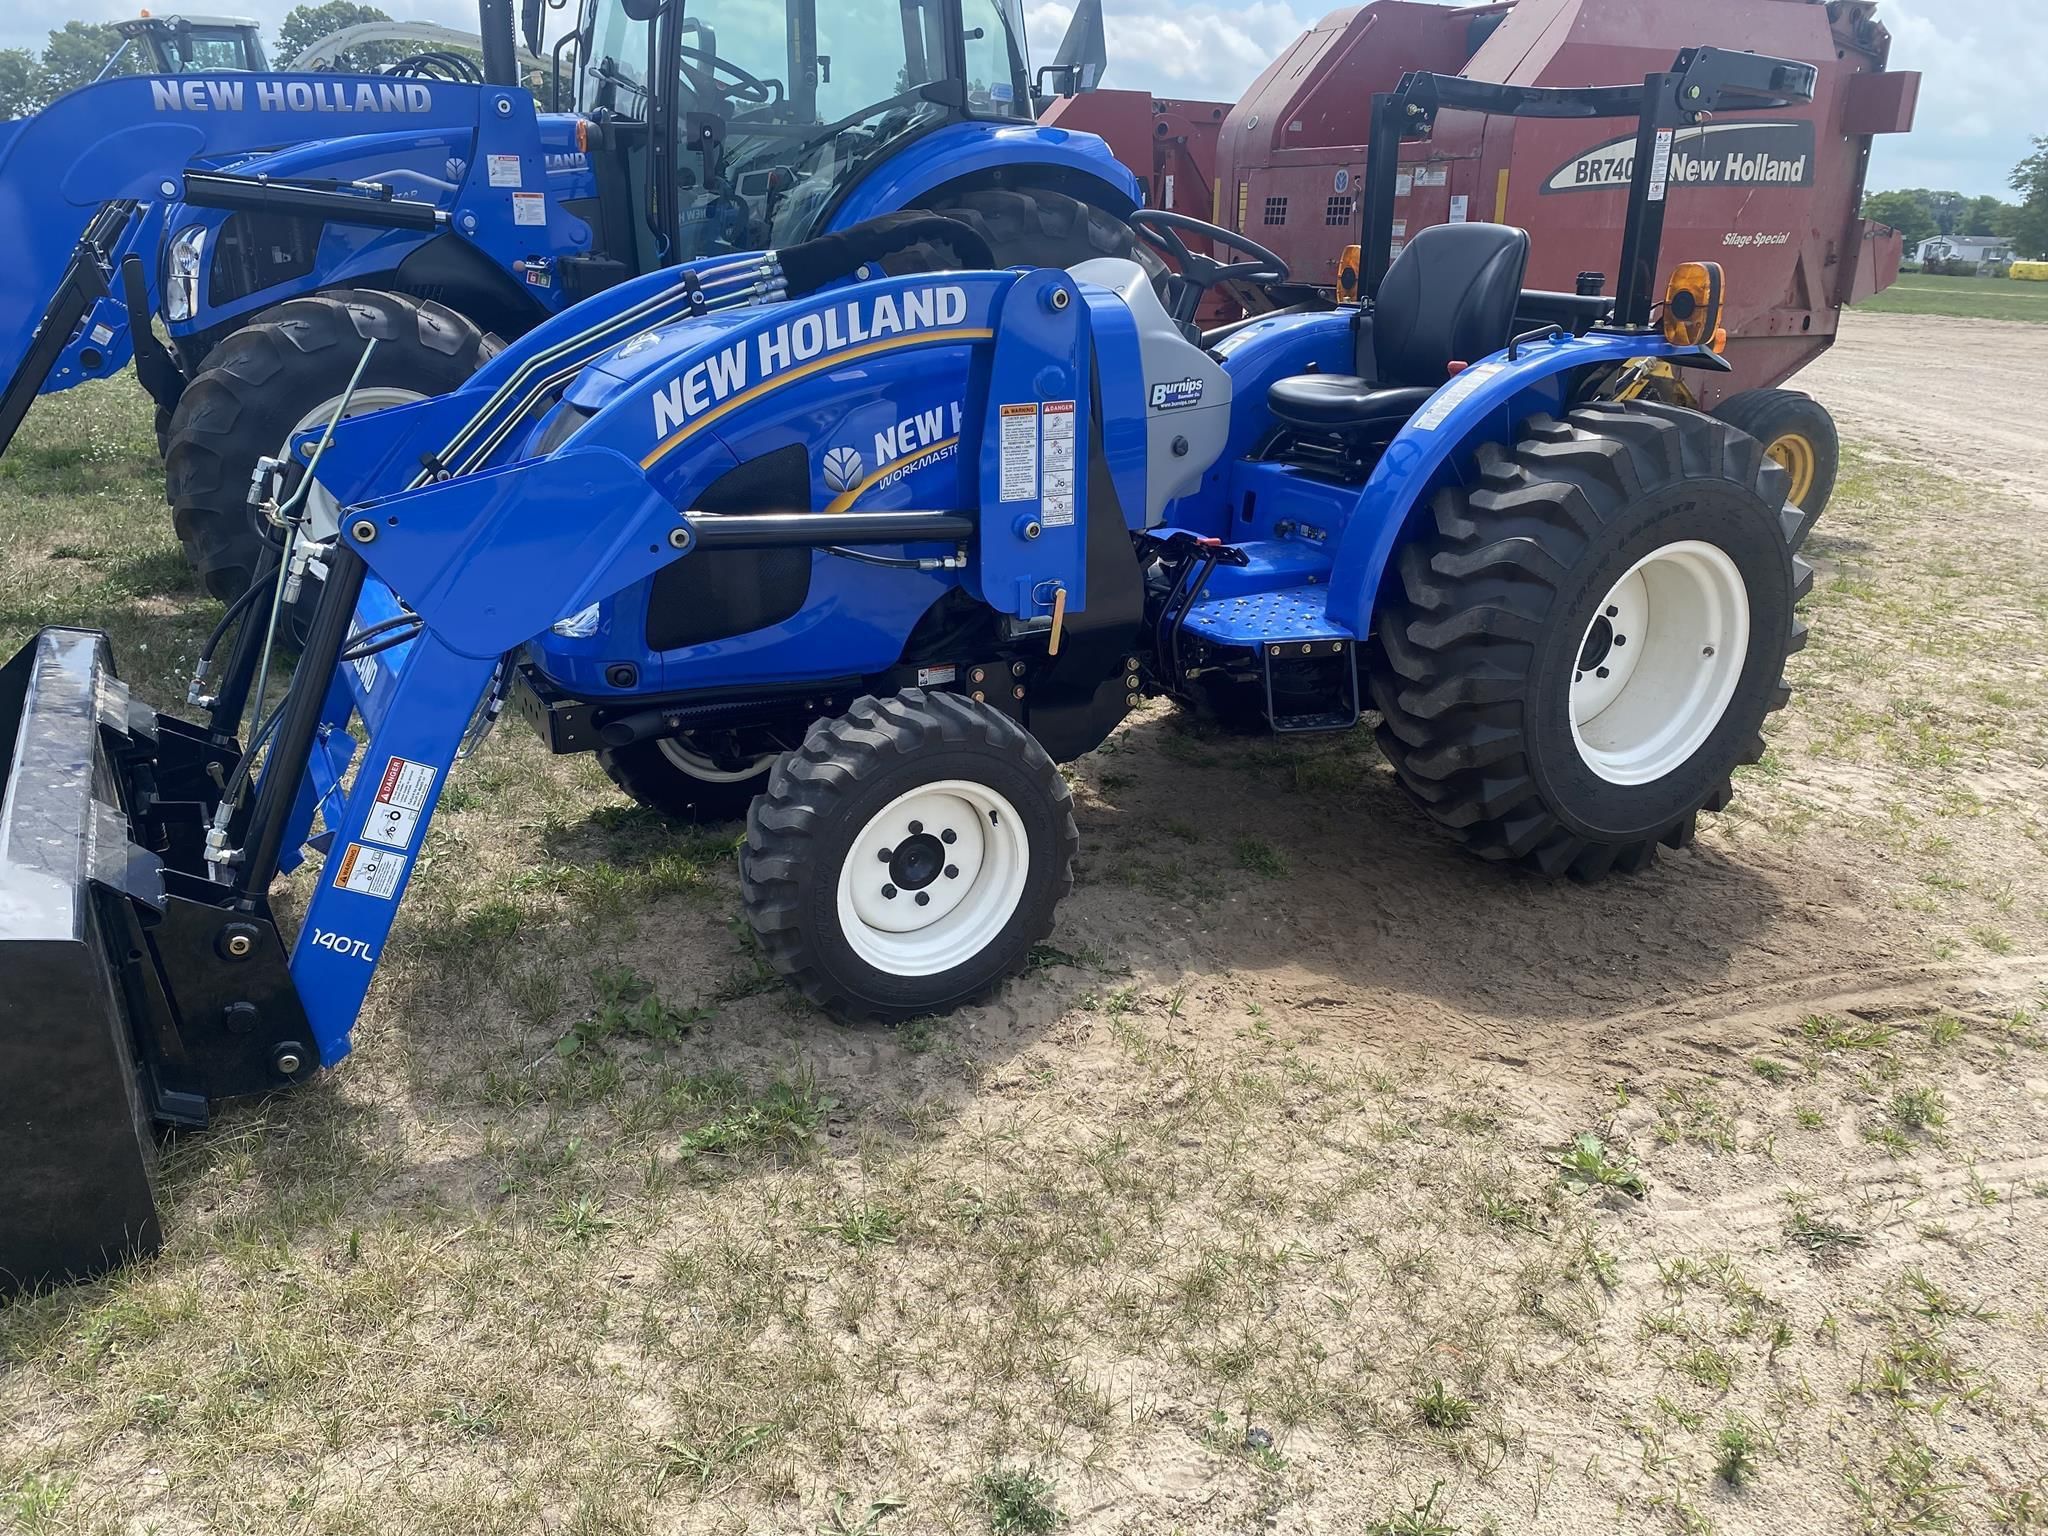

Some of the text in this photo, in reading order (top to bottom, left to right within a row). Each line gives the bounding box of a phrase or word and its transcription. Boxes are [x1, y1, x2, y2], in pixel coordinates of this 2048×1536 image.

[150, 80, 432, 113] NEW HOLLAND
[545, 153, 588, 169] LAND
[1669, 153, 1721, 182] New
[1724, 153, 1806, 182] Holland
[1722, 231, 1790, 248] Silage Special
[652, 286, 967, 440] NEW HOLLAND
[1151, 378, 1203, 405] Burnips
[874, 405, 943, 467] NEW
[880, 443, 958, 491] WORKMASTE
[385, 761, 401, 795] DANGER
[343, 849, 357, 877] WARNING
[312, 927, 373, 962] 140TL
